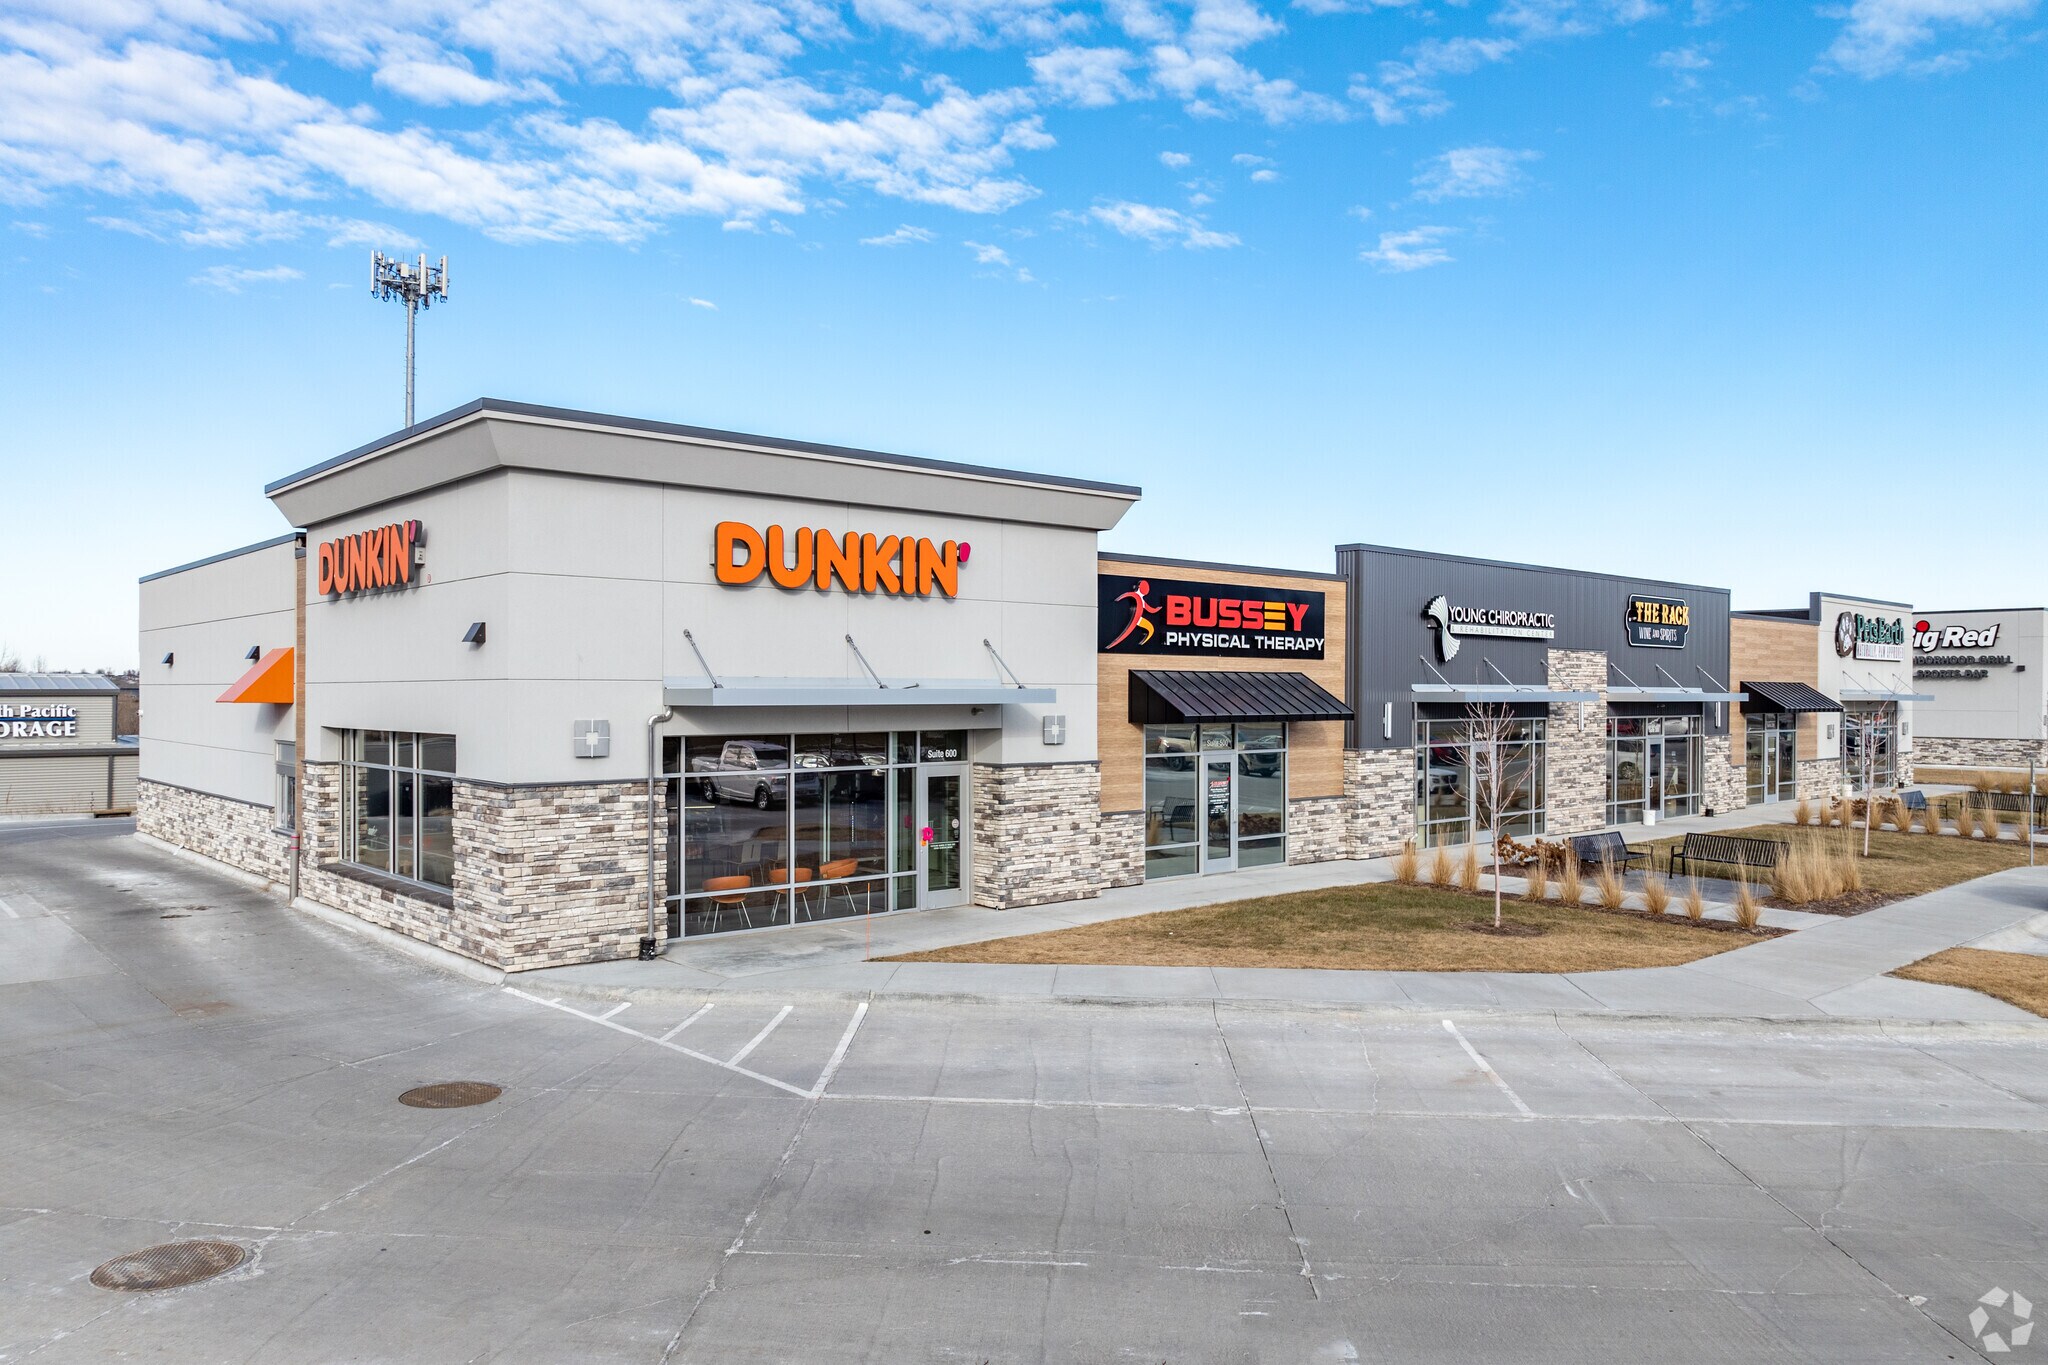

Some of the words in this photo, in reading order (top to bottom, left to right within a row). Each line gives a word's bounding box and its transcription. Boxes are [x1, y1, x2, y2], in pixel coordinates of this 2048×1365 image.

[319, 519, 419, 595] DUNKIN'
[714, 521, 971, 597] DUNKIN'
[1167, 595, 1309, 631] BUSSEY
[1448, 605, 1487, 623] YOUNG
[1488, 609, 1555, 628] CHIROPRACTIC
[1635, 601, 1660, 624] THE
[1661, 603, 1690, 626] RACK
[1166, 631, 1250, 649] PHYSICAL
[1254, 635, 1325, 652] THERAPY
[1459, 626, 1523, 636] REHABILITATION
[1526, 629, 1553, 638] CENTER
[1638, 626, 1652, 640] WINE
[1660, 628, 1677, 642] SPIRITS
[1913, 620, 1940, 653] ig
[1941, 623, 2000, 649] Red
[1916, 669, 1961, 679] SPORTS
[20, 704, 76, 718] Pacific
[928, 750, 944, 758] Suite
[945, 749, 958, 758] 600
